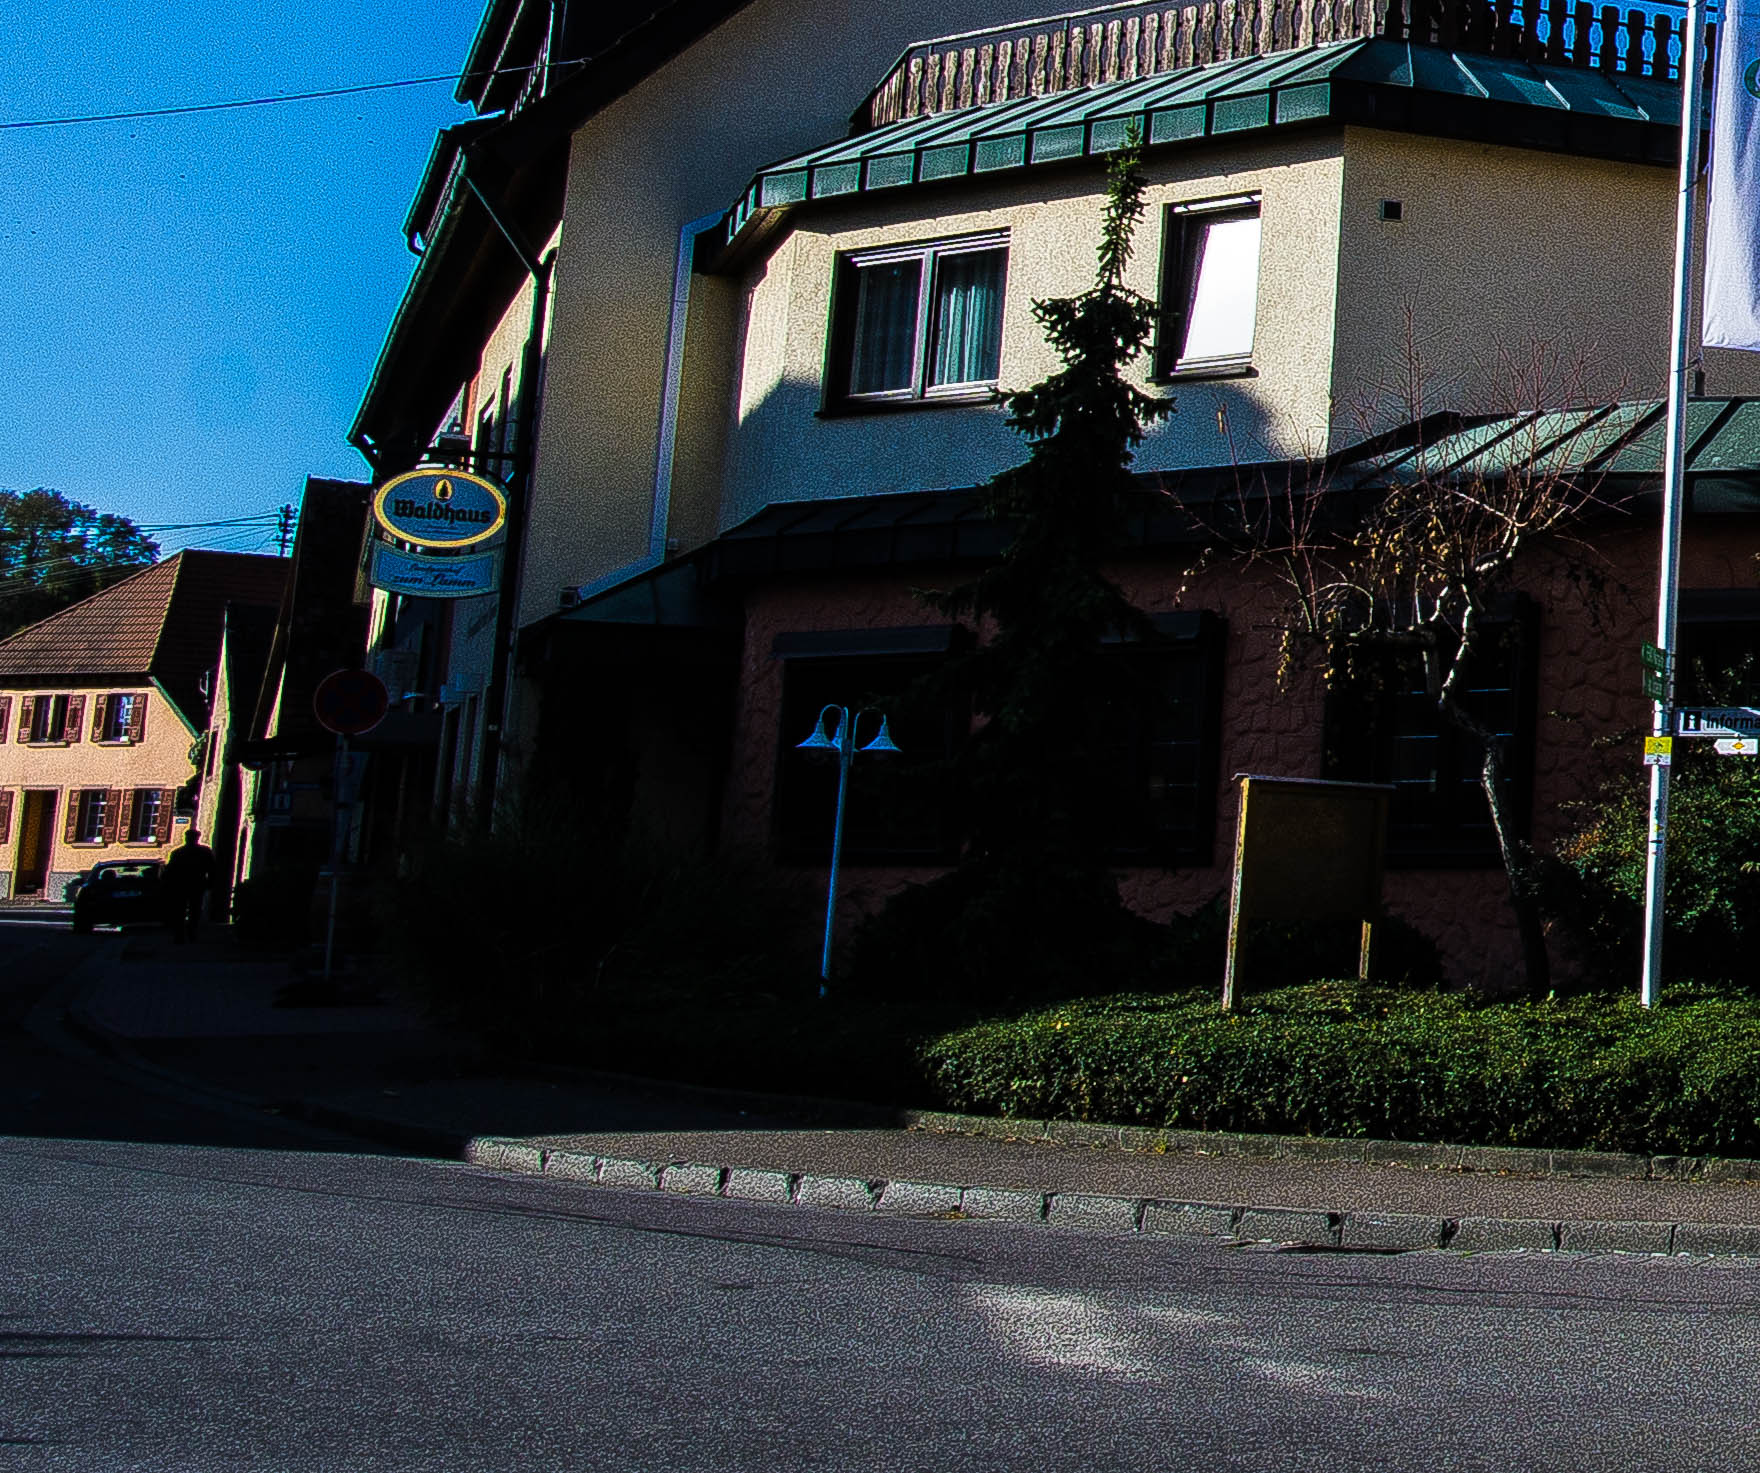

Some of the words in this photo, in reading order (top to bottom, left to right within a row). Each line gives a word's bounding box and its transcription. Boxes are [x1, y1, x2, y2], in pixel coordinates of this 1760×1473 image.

[393, 498, 491, 525] Waldhaus
[393, 575, 424, 585] zum
[427, 573, 476, 587] Lamm
